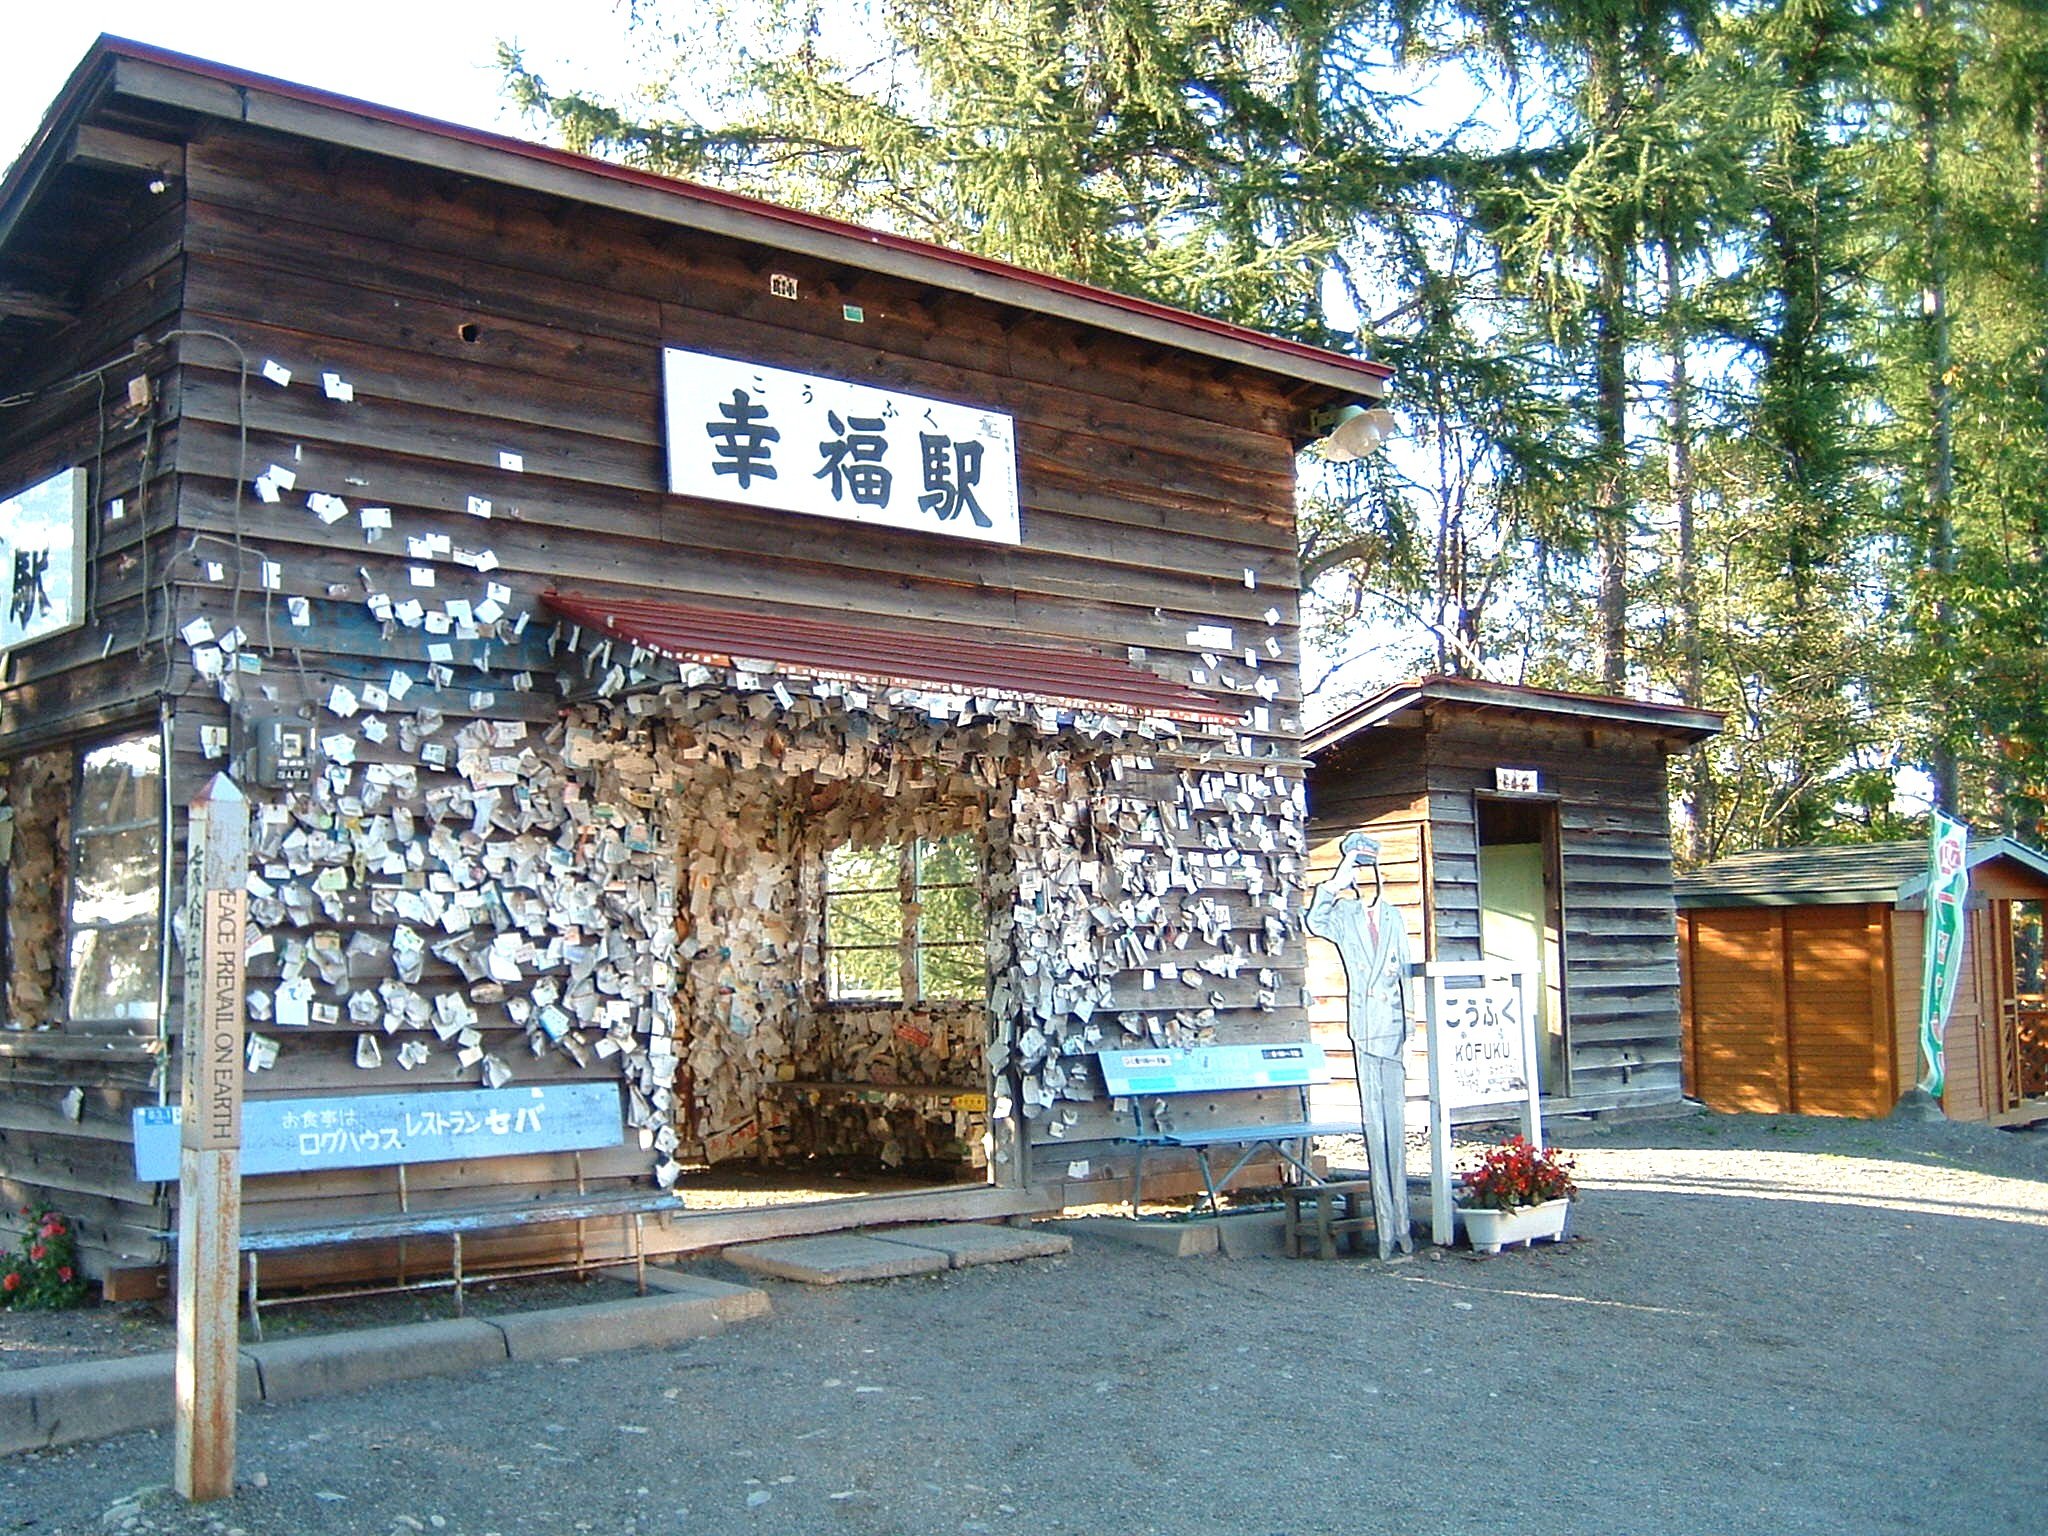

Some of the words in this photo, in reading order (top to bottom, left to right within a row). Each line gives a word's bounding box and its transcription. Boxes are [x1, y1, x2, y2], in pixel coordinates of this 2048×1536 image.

[751, 374, 939, 429] こうふく
[705, 388, 993, 529] 幸福駅
[215, 951, 236, 1031] PREVAIL
[1445, 998, 1517, 1029] こうふく
[214, 1032, 235, 1064] ON
[212, 1069, 233, 1139] EARTH
[299, 1127, 403, 1156] ログハウス
[405, 1110, 481, 1138] レストラン
[485, 1102, 547, 1135] セバ
